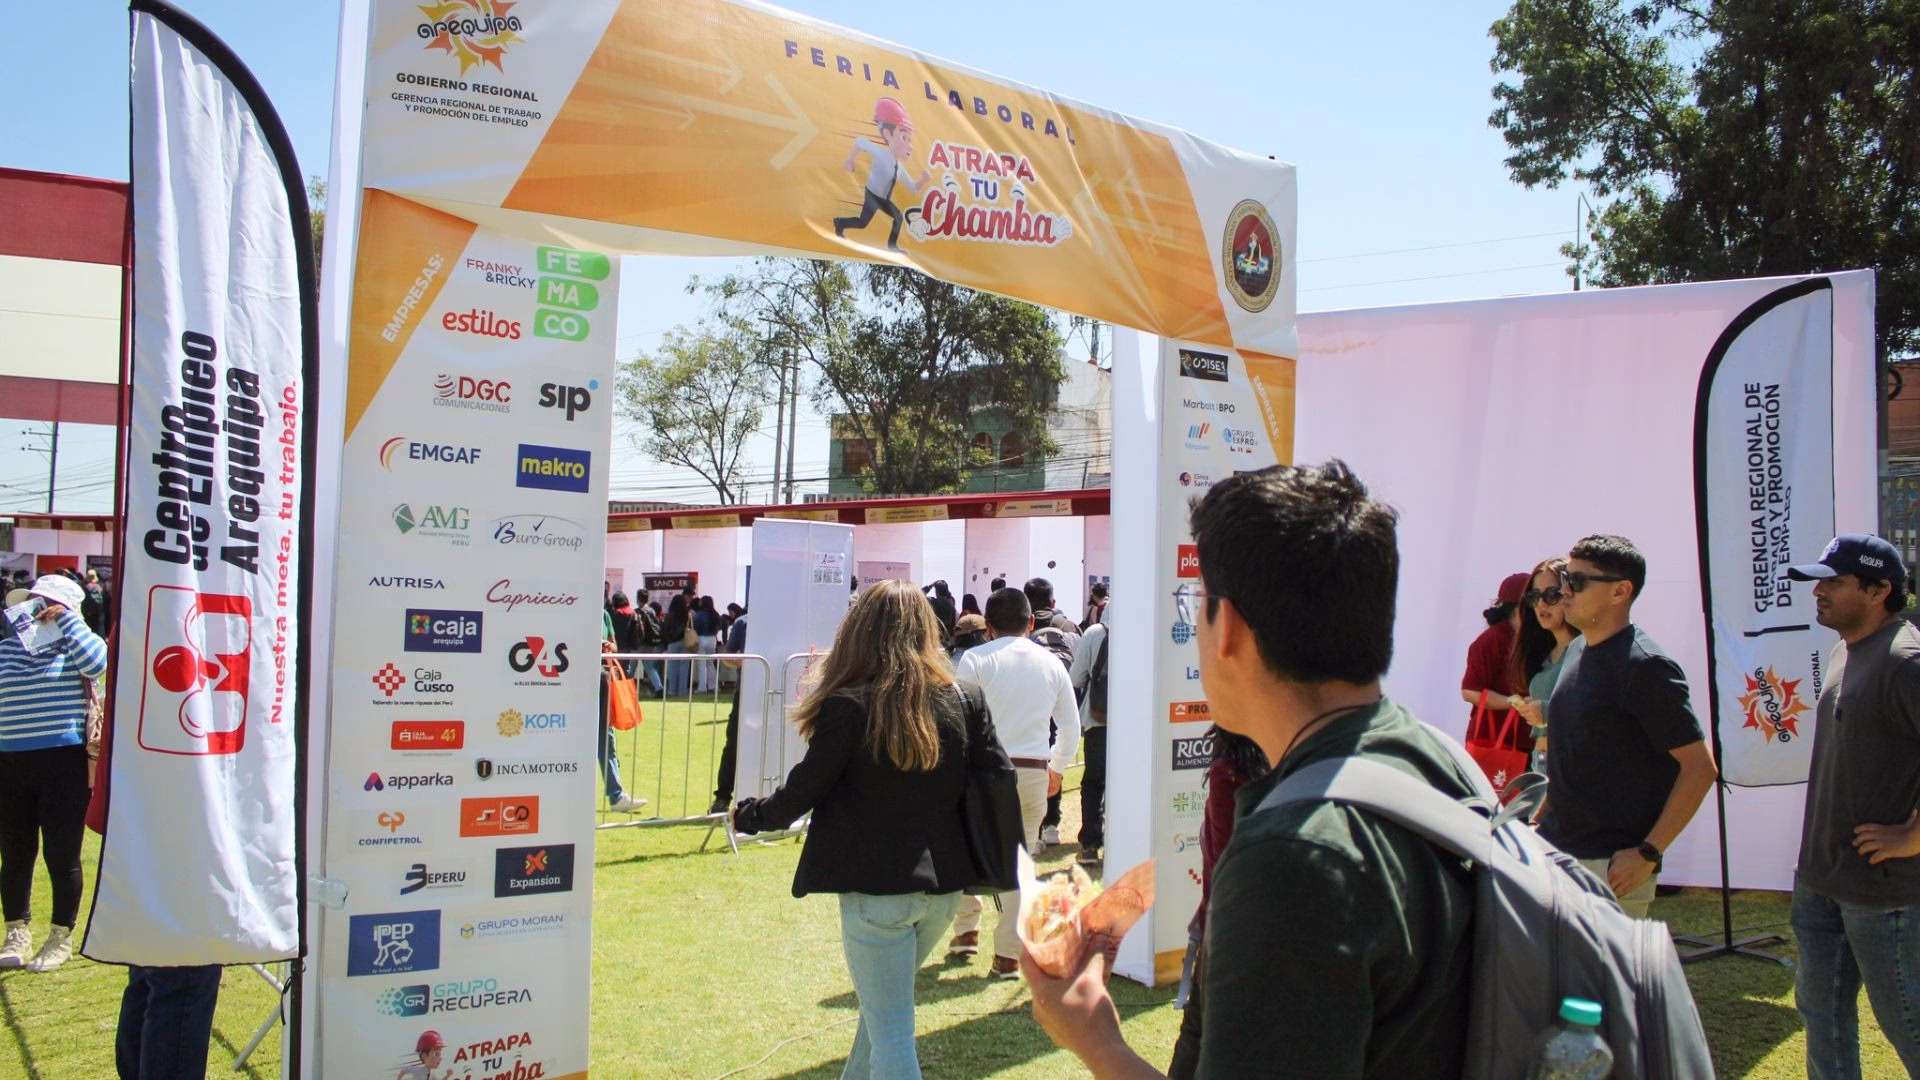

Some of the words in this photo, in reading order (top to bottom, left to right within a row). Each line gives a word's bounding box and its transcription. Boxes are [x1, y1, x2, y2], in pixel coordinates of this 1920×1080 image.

[417, 13, 522, 38] arequipa
[396, 72, 468, 91] GOBIERNO
[472, 83, 538, 102] REGIONAL
[784, 40, 900, 89] FERIA
[925, 81, 1076, 145] LABORAL
[391, 92, 438, 105] GERENCIA
[440, 98, 486, 112] REGIONAL
[488, 104, 501, 114] DE
[503, 107, 542, 120] TRABAJO
[413, 104, 470, 119] PROMOCIÓN
[472, 112, 489, 122] DEL
[491, 115, 528, 127] EMPLEO
[930, 143, 1035, 182] ATRAPA
[970, 178, 998, 200] TU
[922, 190, 1056, 243] Chamba
[466, 258, 522, 275] FRANKY
[546, 252, 582, 273] FE
[485, 272, 535, 289] &RICKY
[381, 253, 444, 344] EMPRESAS:
[546, 282, 580, 306] MA
[442, 308, 521, 340] estilos
[544, 314, 580, 336] CO
[458, 376, 511, 403] DGC
[1744, 382, 1761, 409] DE
[433, 397, 510, 413] COMUNICACIONES
[1219, 403, 1236, 413] BPO
[278, 381, 299, 484] trabajo.
[1761, 384, 1783, 504] PROMOCIÓN
[408, 442, 481, 465] EMGAF
[1746, 412, 1766, 511] REGIONAL
[220, 367, 265, 575] Arequipa
[521, 457, 585, 479] makro
[144, 405, 191, 565] Centro
[278, 493, 294, 520] tu
[419, 505, 470, 530] AMG
[1768, 509, 1783, 522] Y
[1778, 486, 1791, 564] EMPLEO
[276, 530, 294, 607] meta,
[1750, 516, 1769, 613] GERENCIA
[369, 577, 445, 590] AUTRISA
[1776, 575, 1792, 607] DEL
[486, 579, 578, 613] Capriccio
[433, 616, 477, 638] caja
[433, 637, 464, 646] arequipa
[271, 616, 287, 723] Nuestra
[414, 668, 442, 681] Caja
[414, 681, 454, 693] Cusco
[525, 714, 566, 729] KORI
[497, 763, 577, 775] INCAMOTORS
[388, 773, 453, 790] apparka
[359, 837, 422, 846] CONFIPETROL
[510, 876, 561, 889] Expansion
[478, 919, 519, 930] GRUPO
[522, 914, 564, 926] MORAN
[433, 978, 498, 998] GRUPO
[404, 995, 425, 1007] GR
[432, 989, 532, 1012] RECUPERA
[454, 1032, 532, 1064] ATRAPA
[483, 1057, 502, 1072] TU
